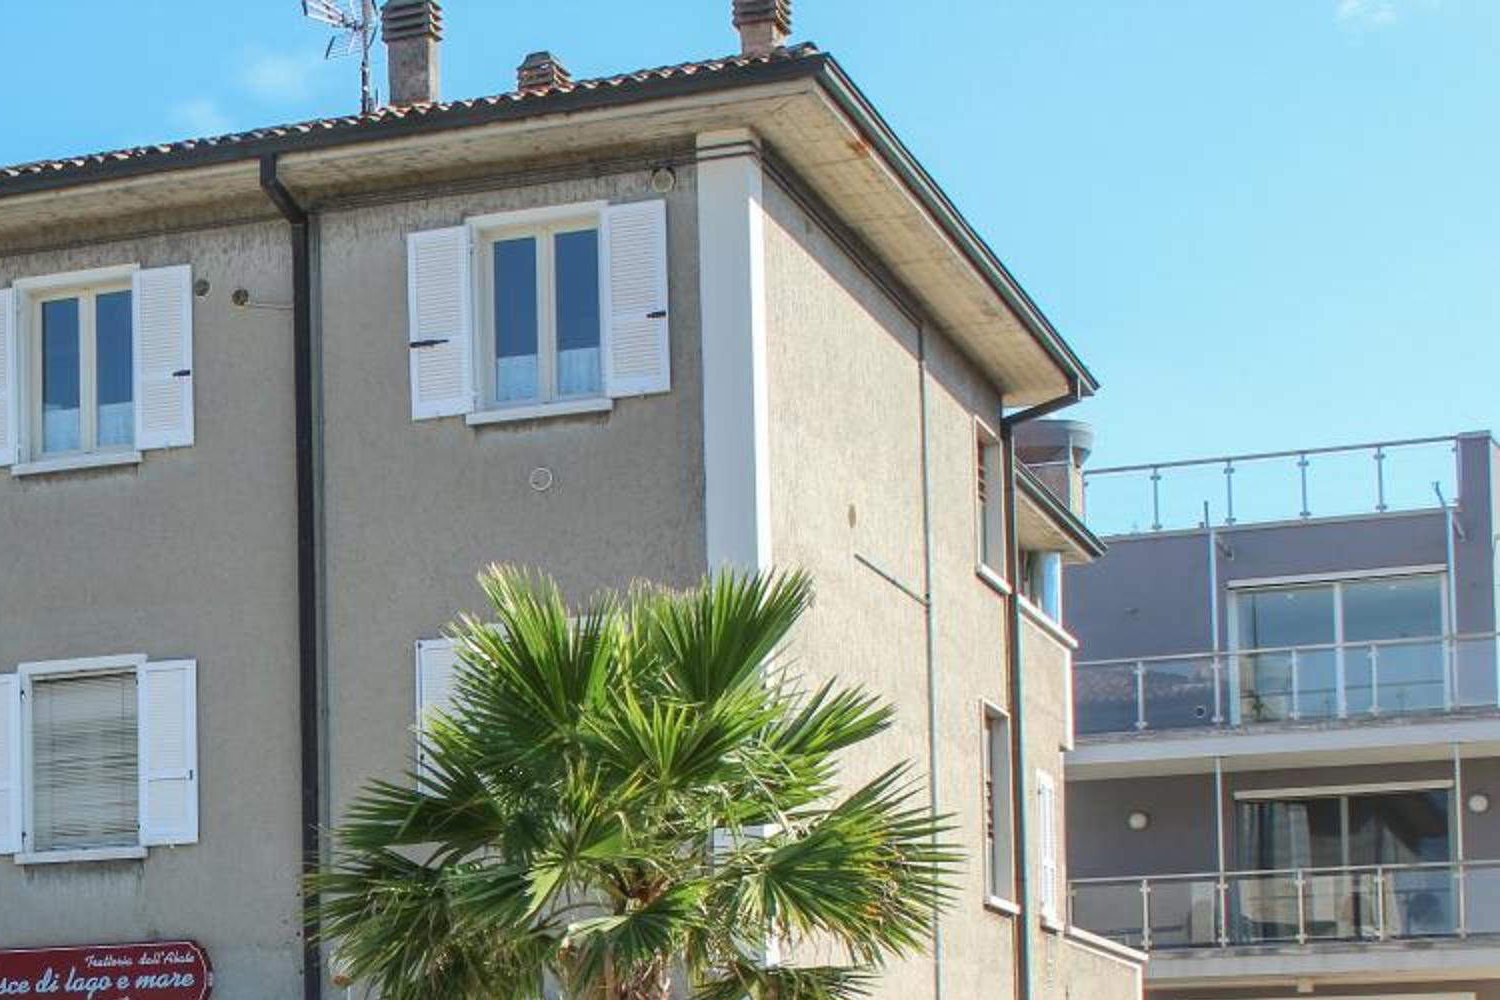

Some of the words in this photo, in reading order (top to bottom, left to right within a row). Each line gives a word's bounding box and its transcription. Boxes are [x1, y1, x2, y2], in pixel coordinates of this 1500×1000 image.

[35, 967, 60, 993] di
[64, 966, 112, 1000] lago
[116, 977, 130, 990] e
[135, 971, 195, 989] mare
